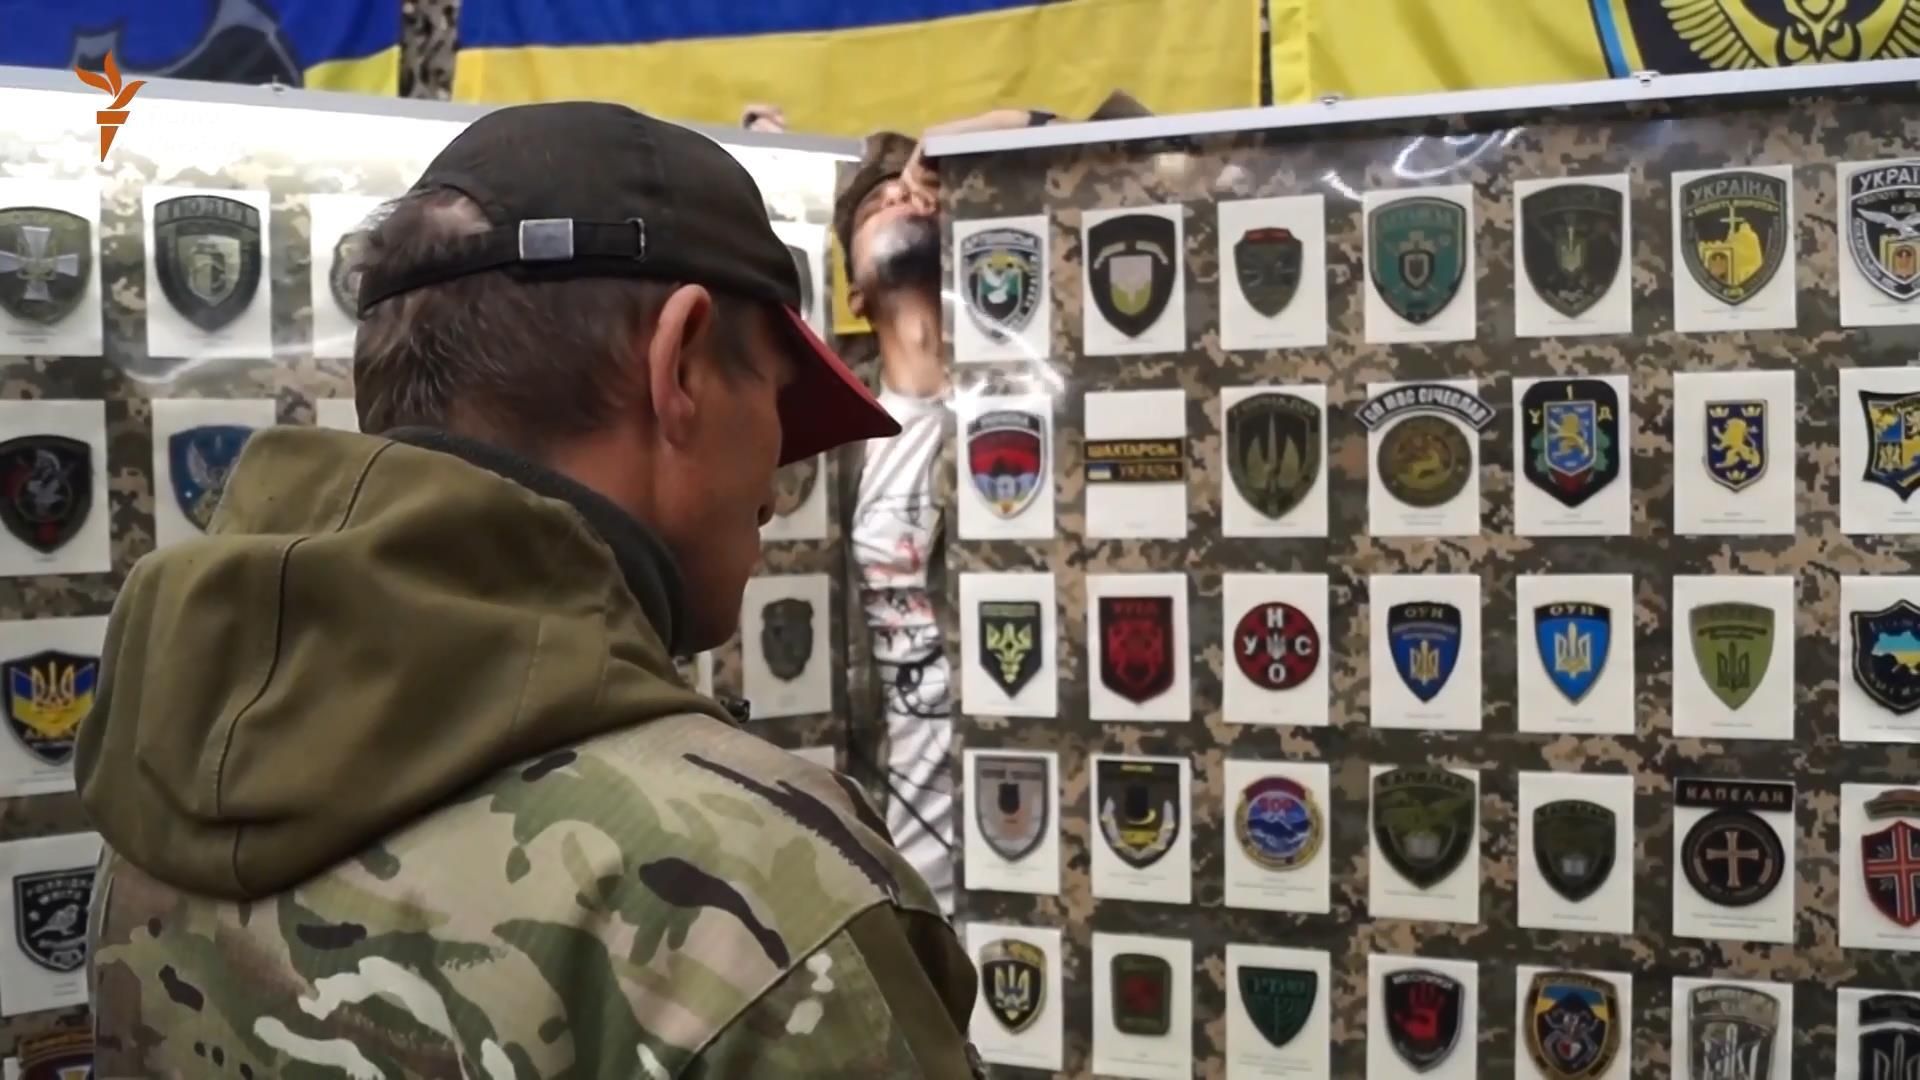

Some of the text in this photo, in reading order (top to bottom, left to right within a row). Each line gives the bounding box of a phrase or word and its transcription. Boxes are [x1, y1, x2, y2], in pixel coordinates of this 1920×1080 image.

[1692, 176, 1776, 201] УКРАЇНА
[1266, 607, 1283, 628] Н
[1404, 605, 1443, 619] ОУН
[1549, 603, 1593, 617] ОУН
[1243, 635, 1312, 656] У С
[1268, 663, 1286, 683] О
